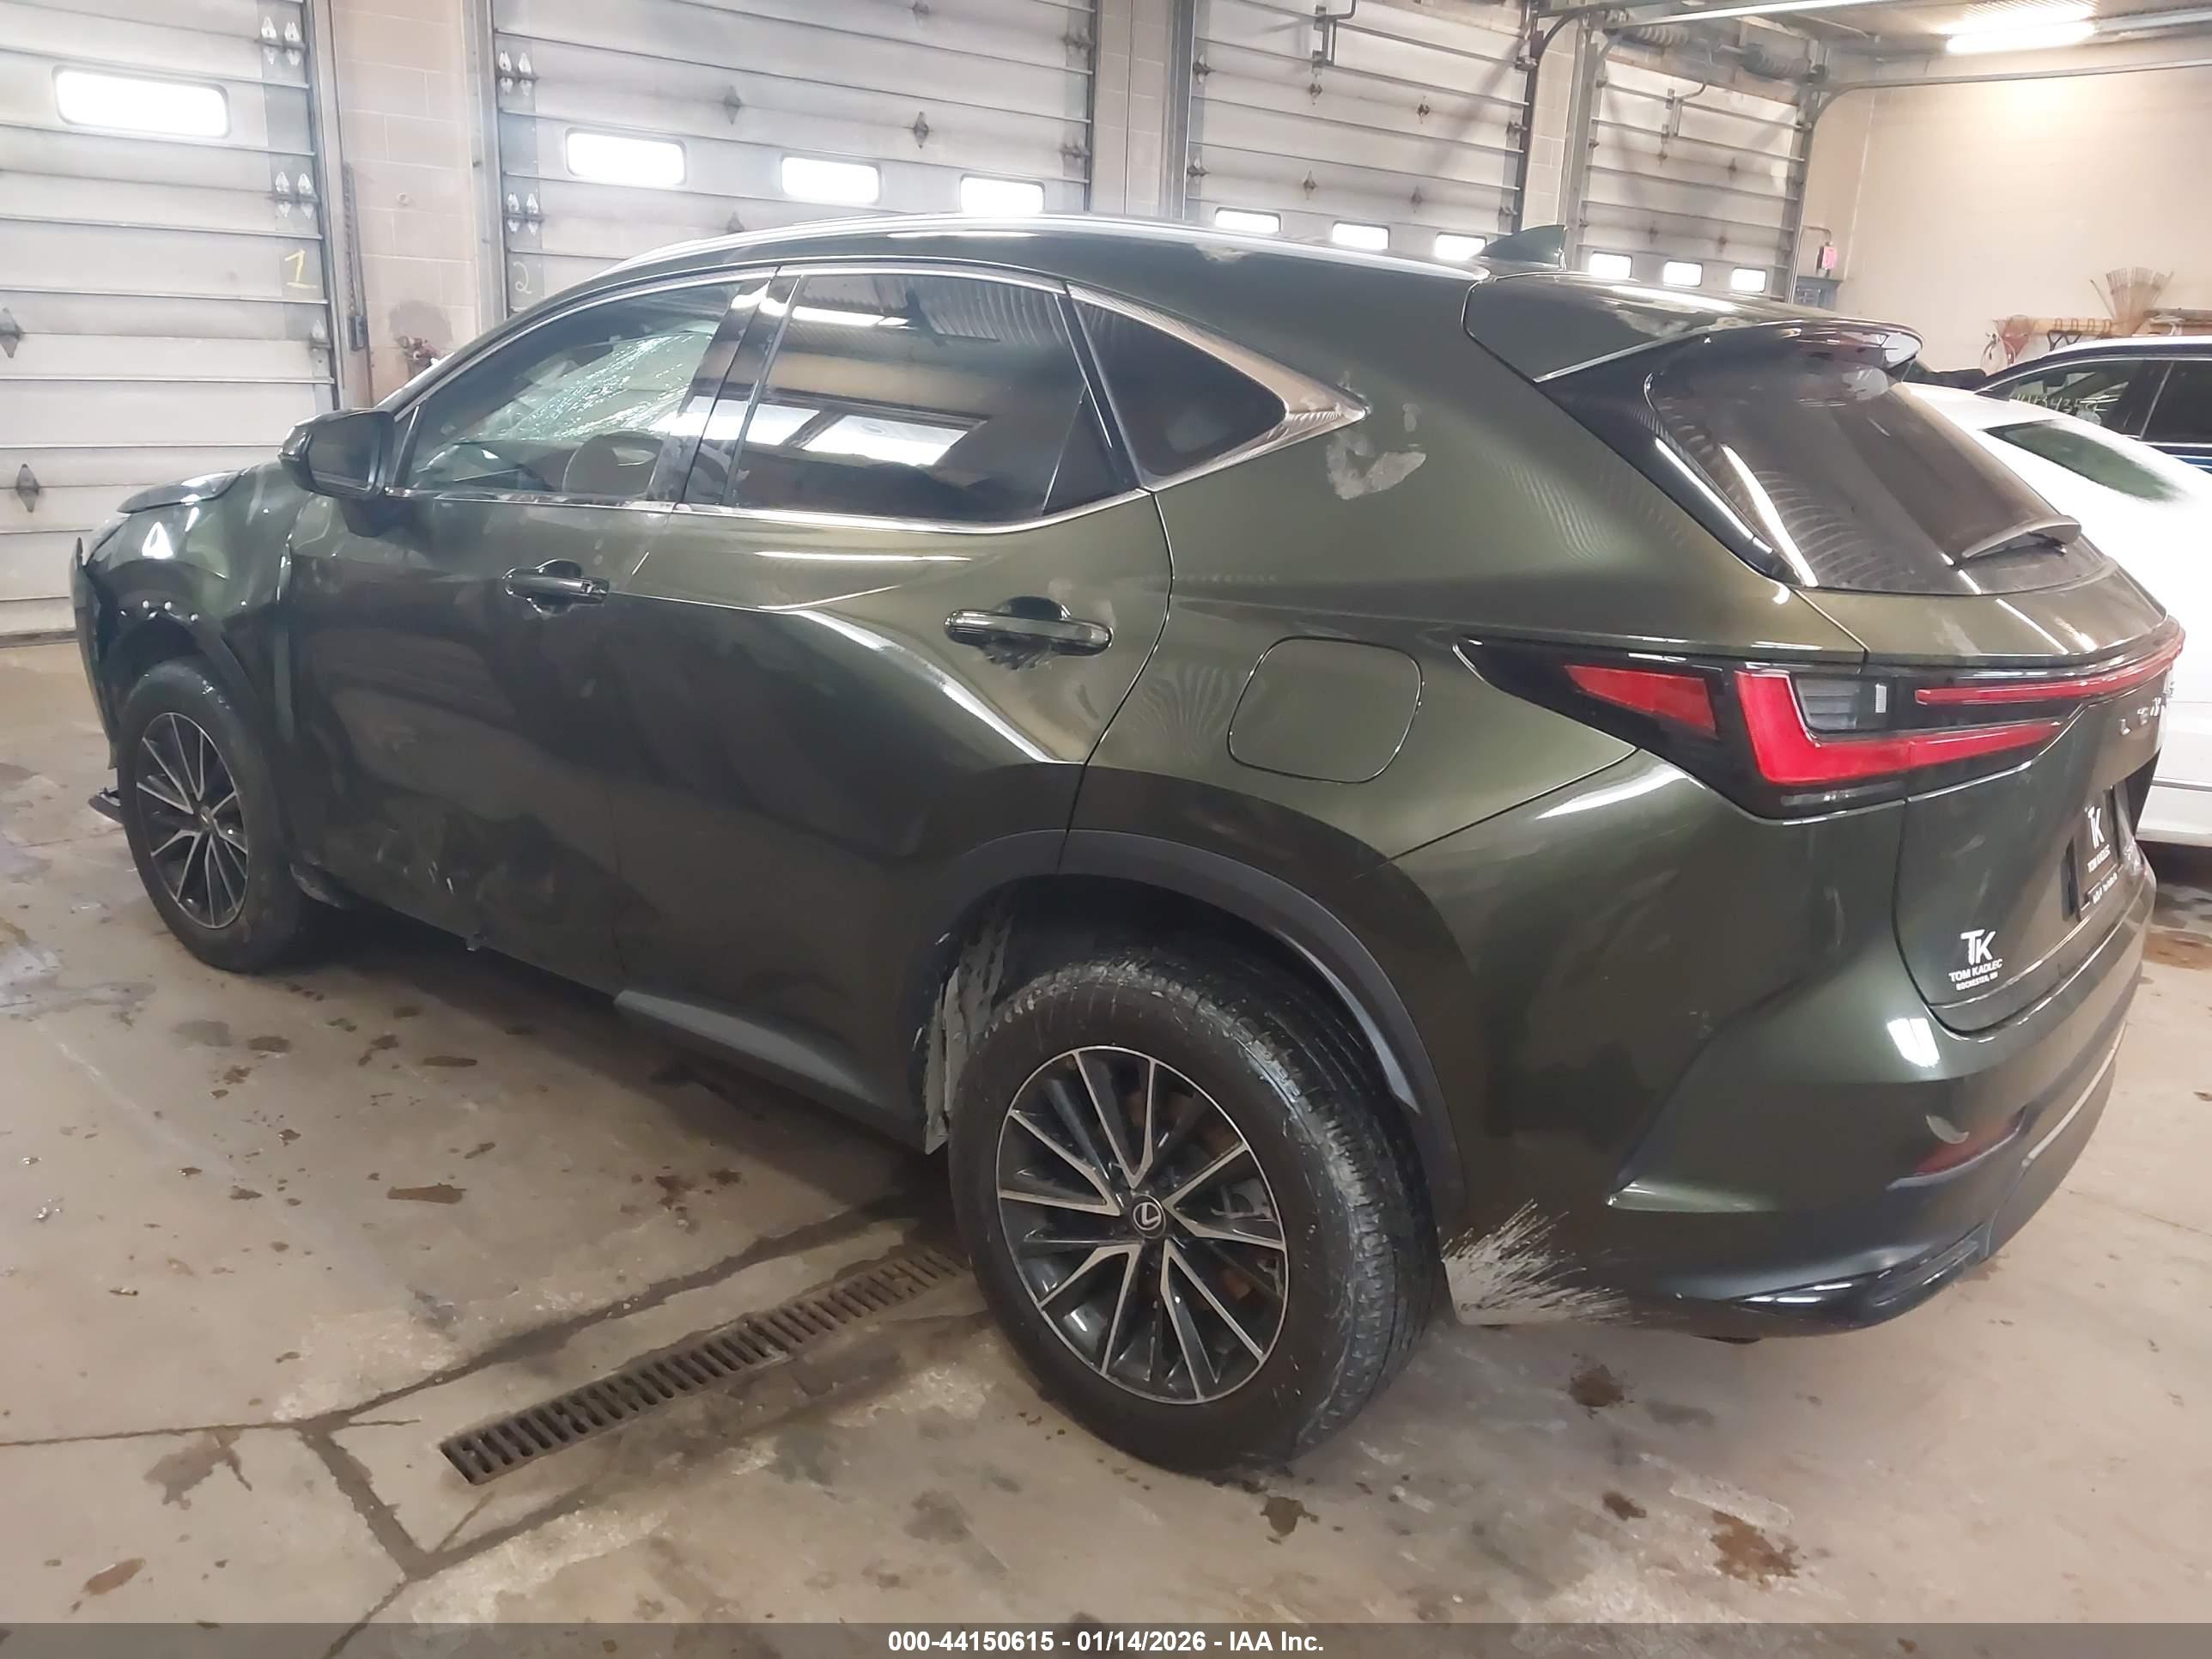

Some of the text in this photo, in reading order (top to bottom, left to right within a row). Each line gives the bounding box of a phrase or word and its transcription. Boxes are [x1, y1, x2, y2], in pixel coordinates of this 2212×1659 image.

[284, 249, 317, 289] 1
[513, 260, 532, 295] 2
[1960, 929, 1996, 965] TK
[1948, 958, 2002, 981] TOM KADLEC
